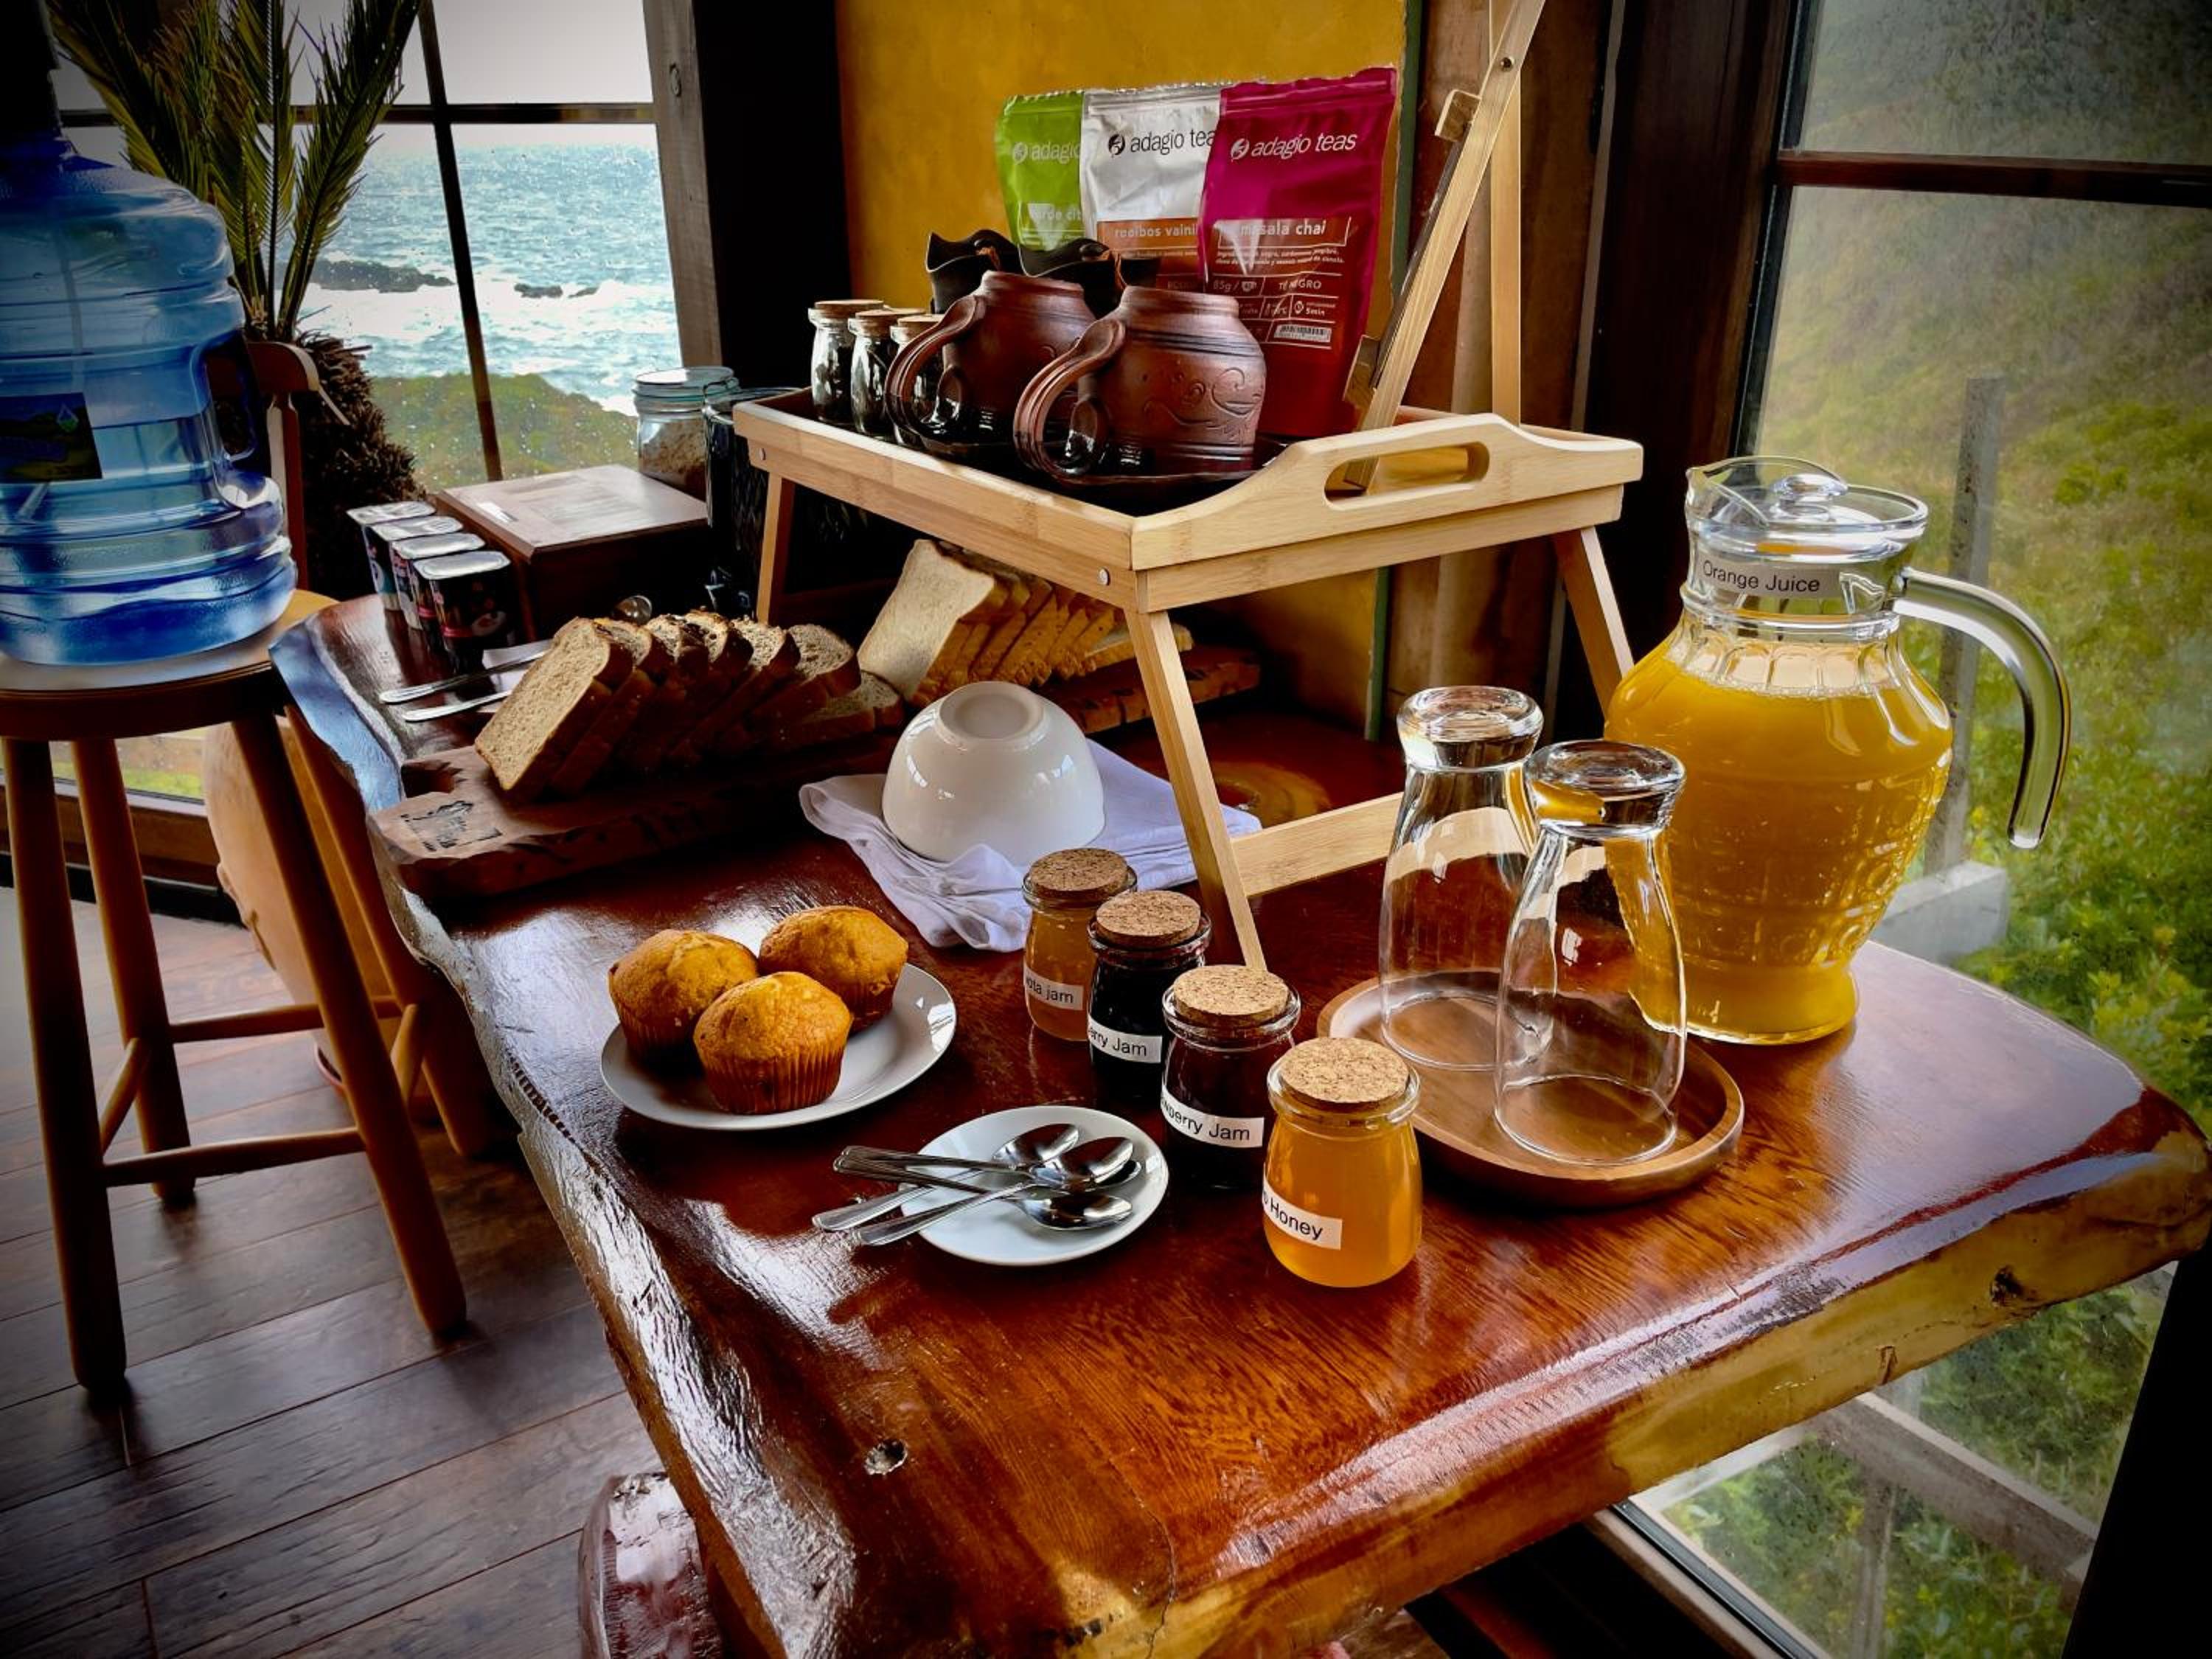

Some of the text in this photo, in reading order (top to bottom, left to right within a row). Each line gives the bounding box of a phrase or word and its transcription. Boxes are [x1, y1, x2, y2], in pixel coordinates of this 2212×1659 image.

[1130, 130, 1185, 156] adagio
[1251, 132, 1358, 159] adagio teas
[1114, 224, 1161, 237] rooibos
[1295, 219, 1326, 235] chai
[1703, 560, 1820, 593] Orange Juice
[1112, 1037, 1147, 1057] Jam
[1209, 1123, 1251, 1141] Jam
[1270, 1197, 1324, 1241] Honey
